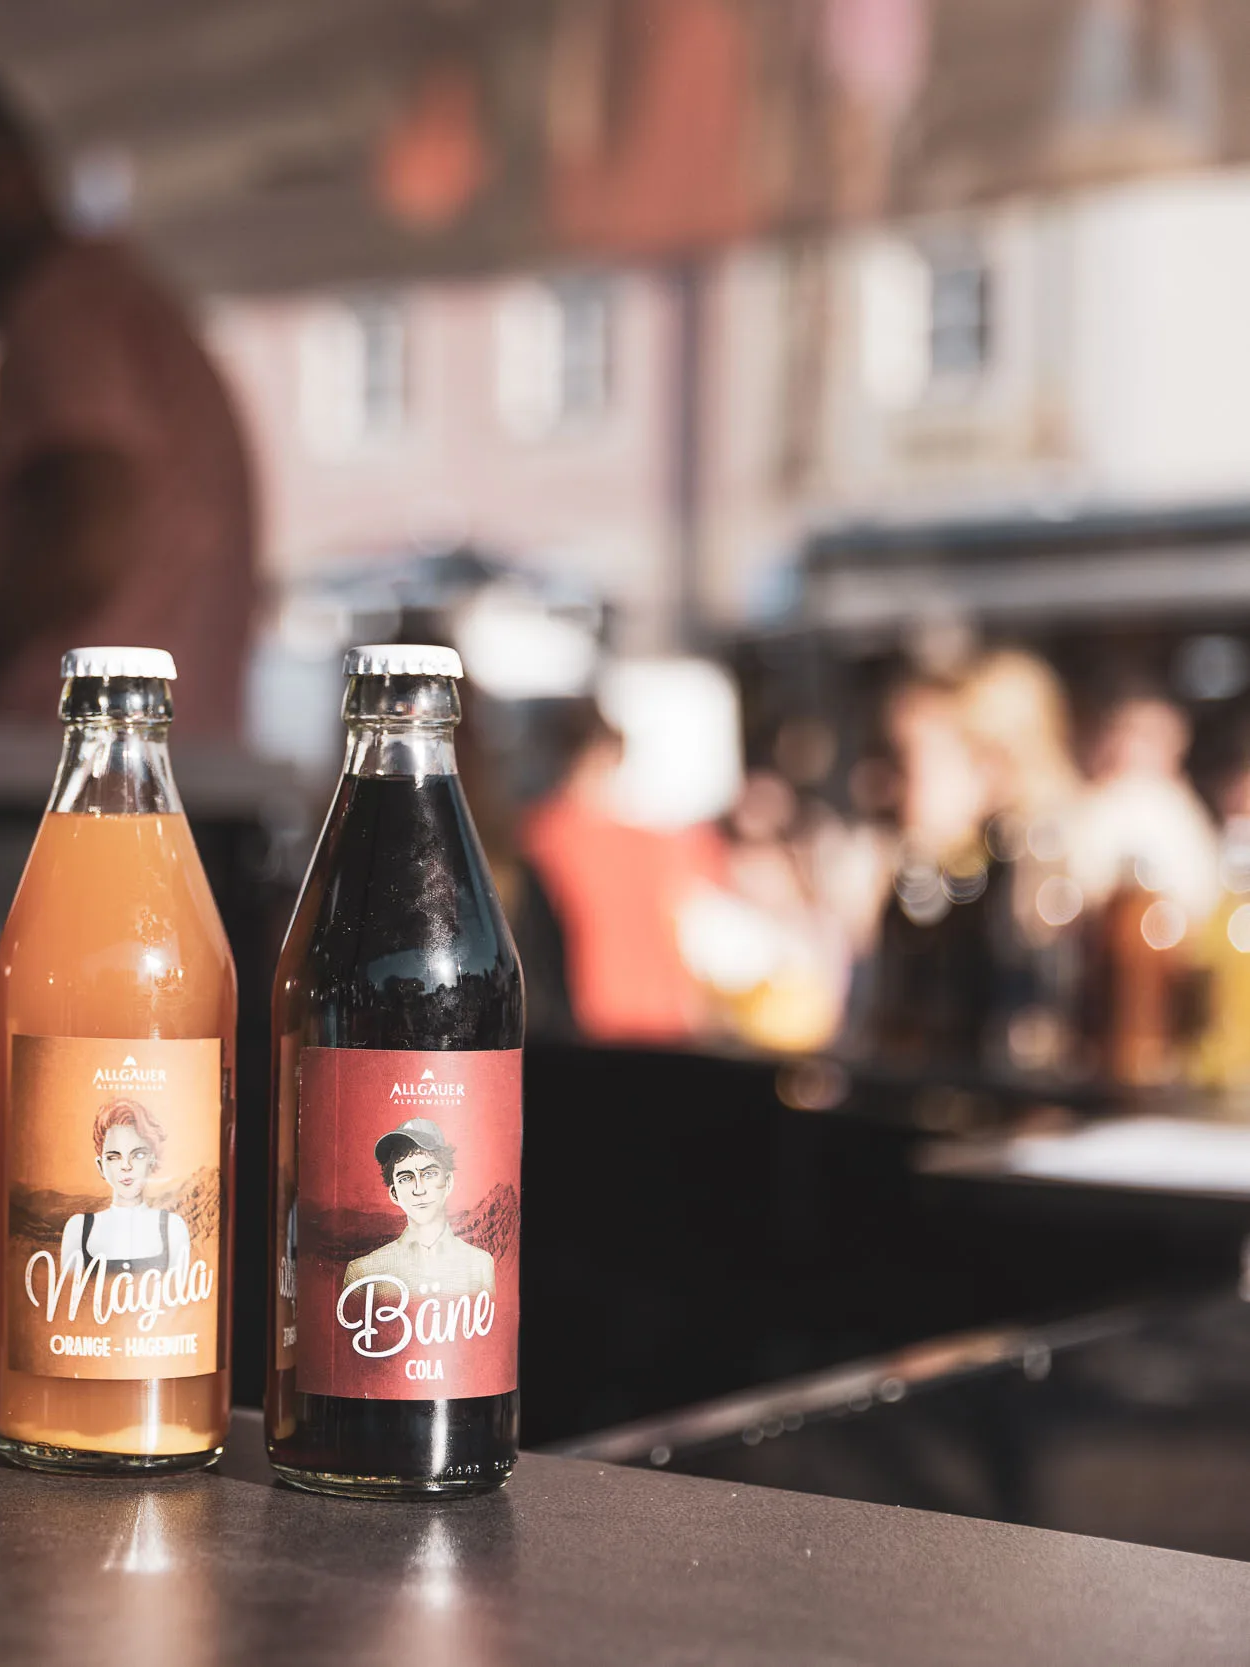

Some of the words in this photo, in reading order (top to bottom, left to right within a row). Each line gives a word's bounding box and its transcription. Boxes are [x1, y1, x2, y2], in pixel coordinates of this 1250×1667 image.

[92, 1066, 167, 1085] ALLGÄUER
[389, 1081, 465, 1099] ALLGÄUER
[25, 1245, 214, 1332] Magda
[336, 1274, 495, 1358] Bäne
[50, 1334, 111, 1357] ORANGE
[405, 1359, 444, 1380] COLA
